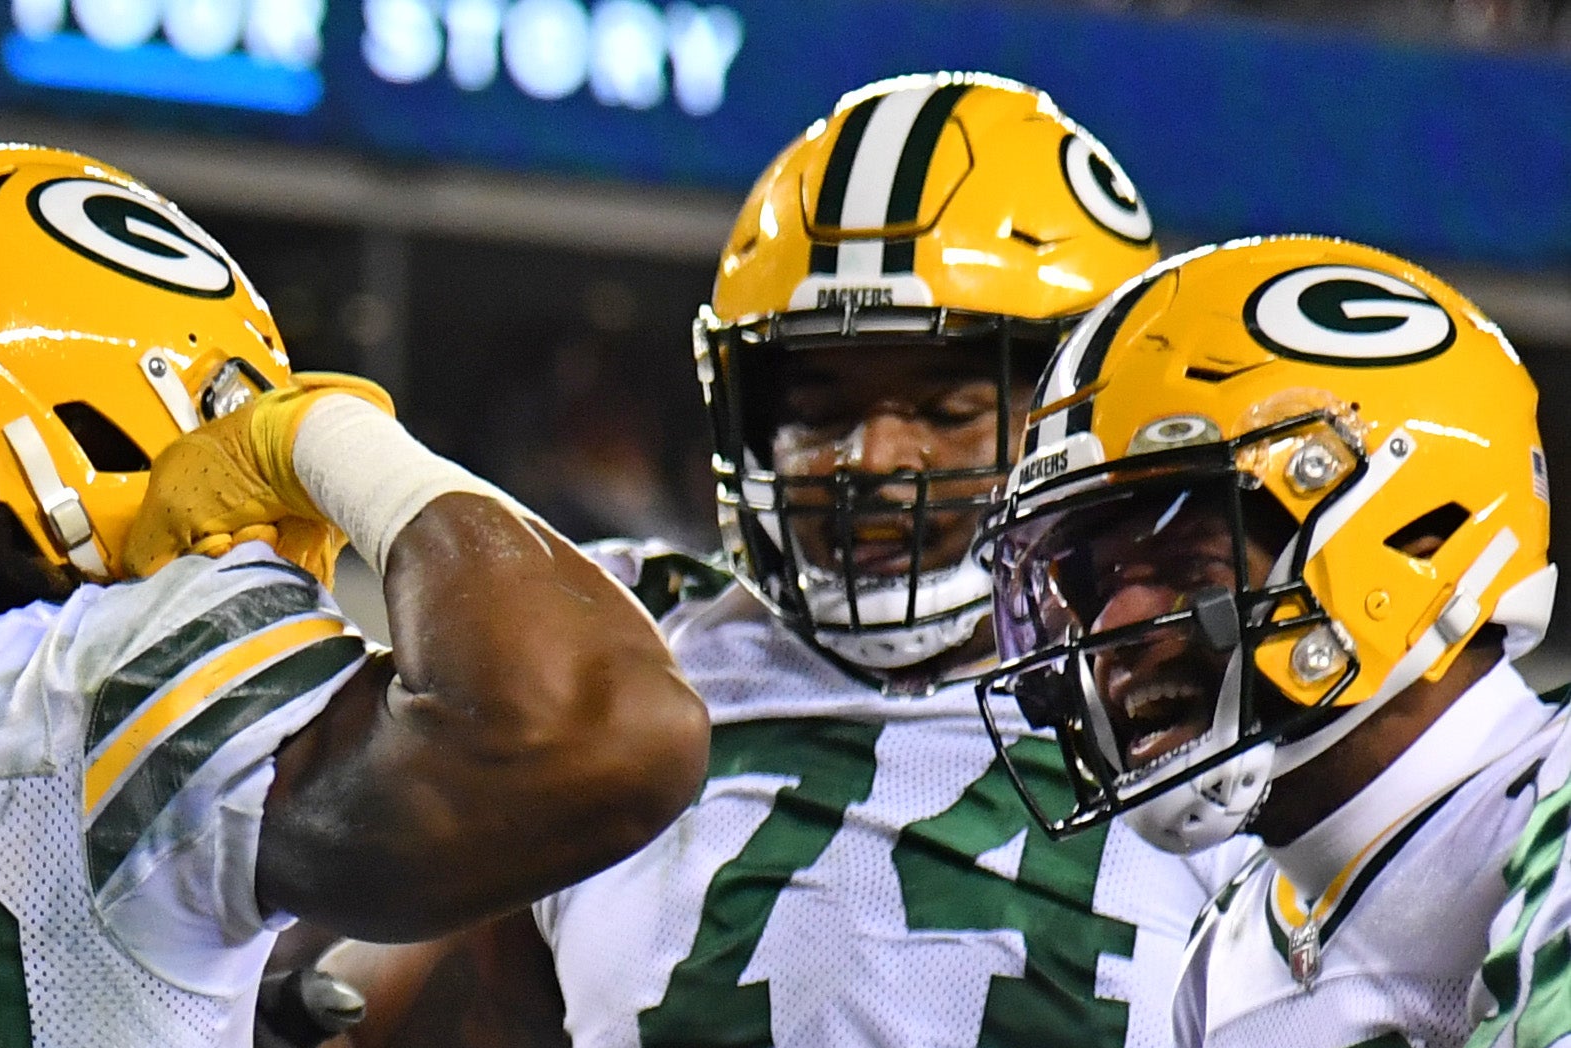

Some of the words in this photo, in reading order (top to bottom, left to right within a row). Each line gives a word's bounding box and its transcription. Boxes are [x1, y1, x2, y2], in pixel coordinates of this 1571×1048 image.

[361, 0, 745, 116] STORY
[37, 178, 232, 293] G
[1253, 265, 1453, 361] G
